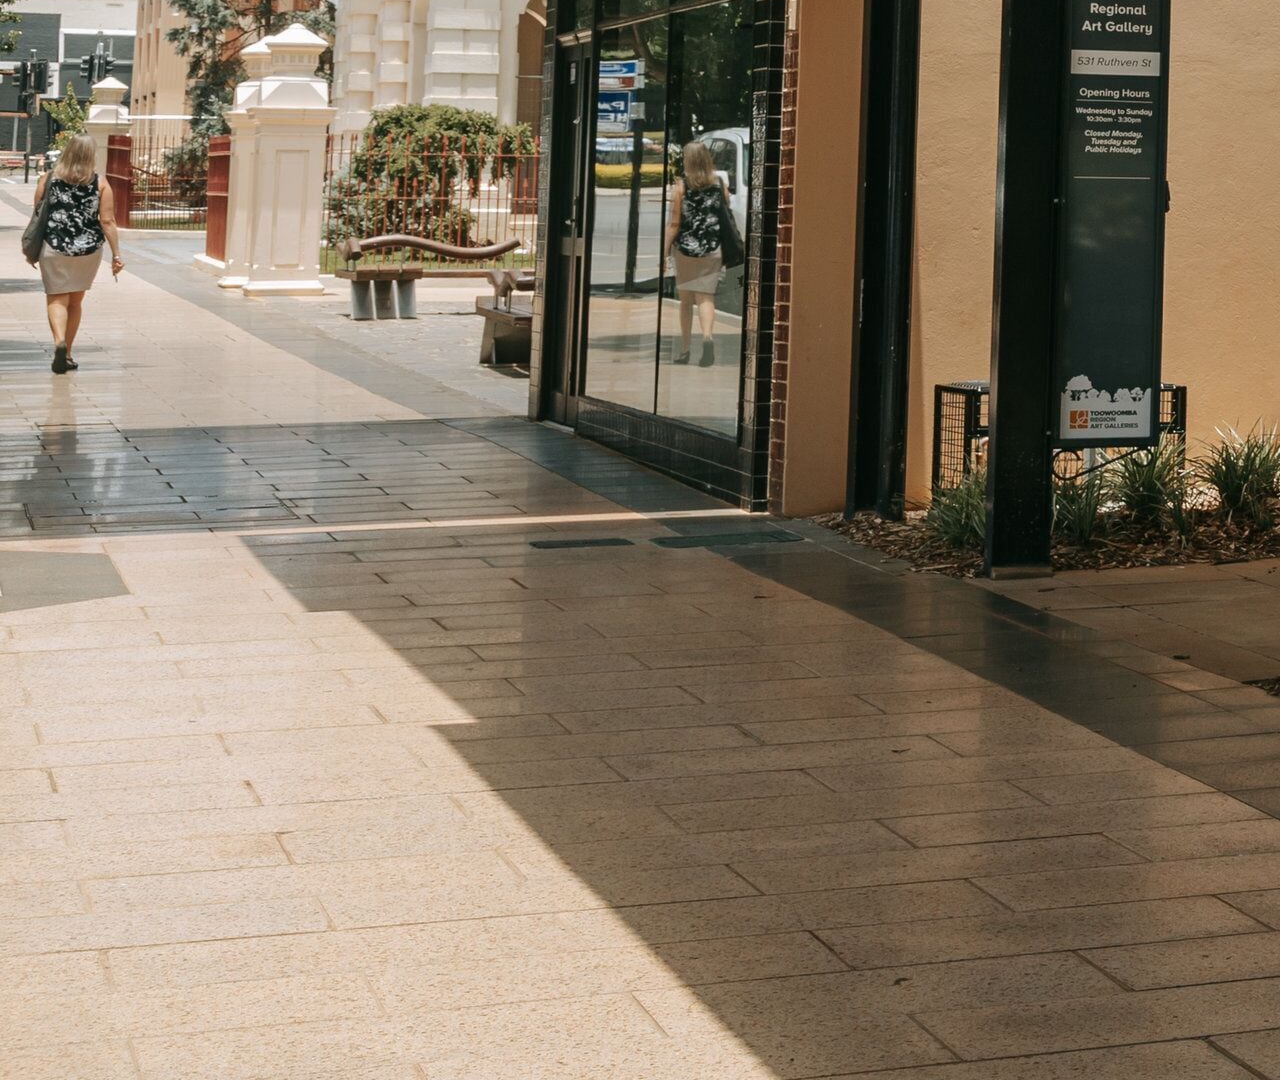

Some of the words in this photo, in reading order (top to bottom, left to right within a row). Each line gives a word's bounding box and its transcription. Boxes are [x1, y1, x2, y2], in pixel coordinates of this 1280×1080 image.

[1090, 3, 1146, 16] Regional
[1082, 20, 1102, 31] Art
[1106, 22, 1152, 35] Gallery
[1077, 57, 1094, 65] 531
[1097, 57, 1138, 67] Ruthven
[1141, 59, 1151, 67] St
[1079, 88, 1119, 98] Opening
[1122, 89, 1150, 98] Hours
[1076, 107, 1116, 115] Wednesday
[1085, 145, 1108, 153] Public
[1110, 146, 1142, 154] Holidays
